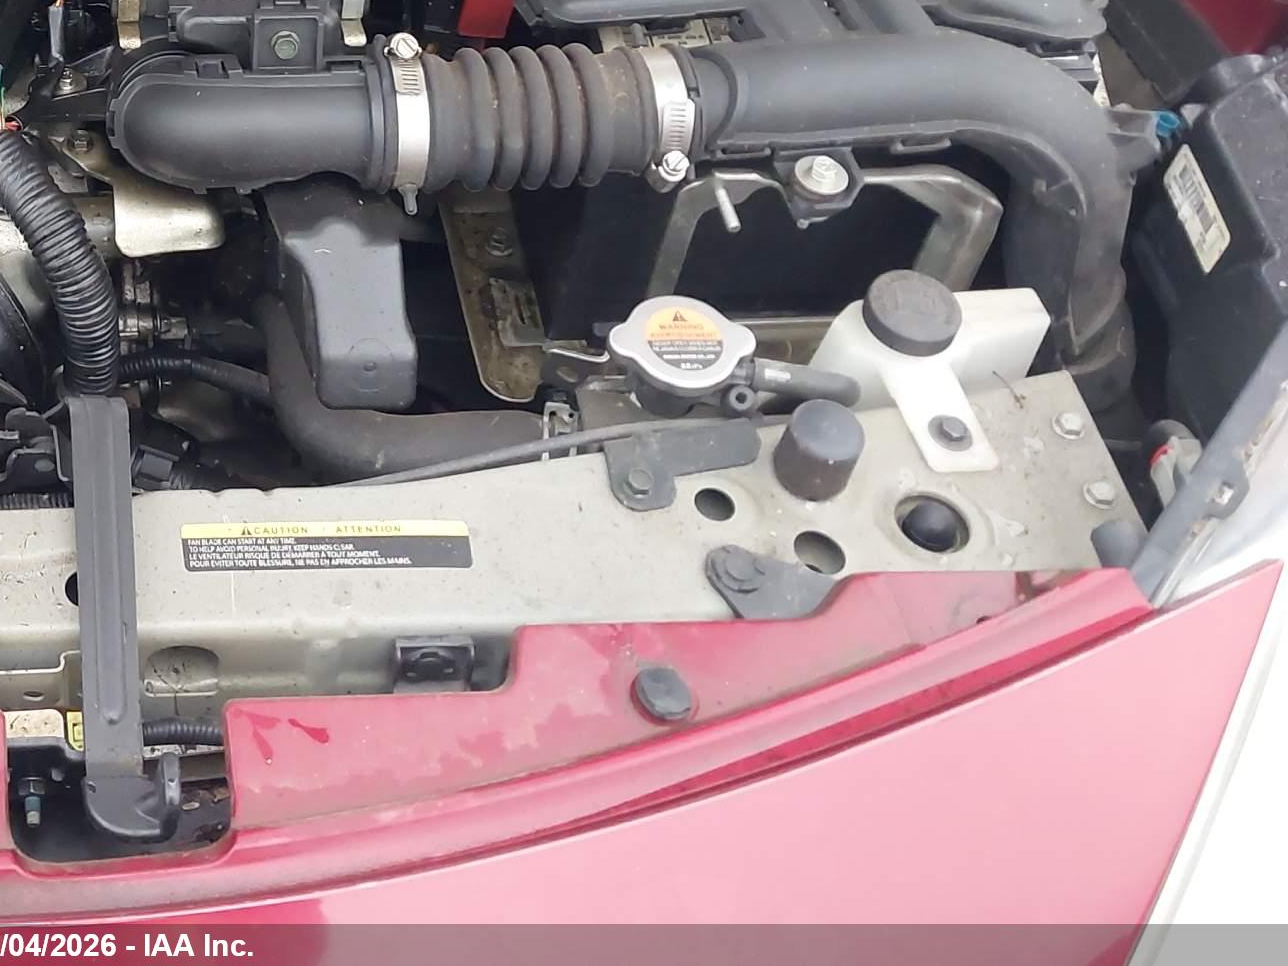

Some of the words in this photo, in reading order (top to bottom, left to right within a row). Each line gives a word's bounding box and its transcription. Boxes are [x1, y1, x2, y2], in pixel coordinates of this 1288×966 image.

[253, 526, 309, 535] CAUTION
[335, 524, 401, 534] ATTENTION
[188, 538, 201, 546] FAN
[222, 538, 237, 546] CAN
[257, 537, 266, 545] AT
[189, 553, 199, 561] LE
[244, 552, 270, 560] RISQUE
[233, 559, 257, 567] TOUTE
[305, 558, 319, 566] PAS
[374, 557, 387, 565] LES
